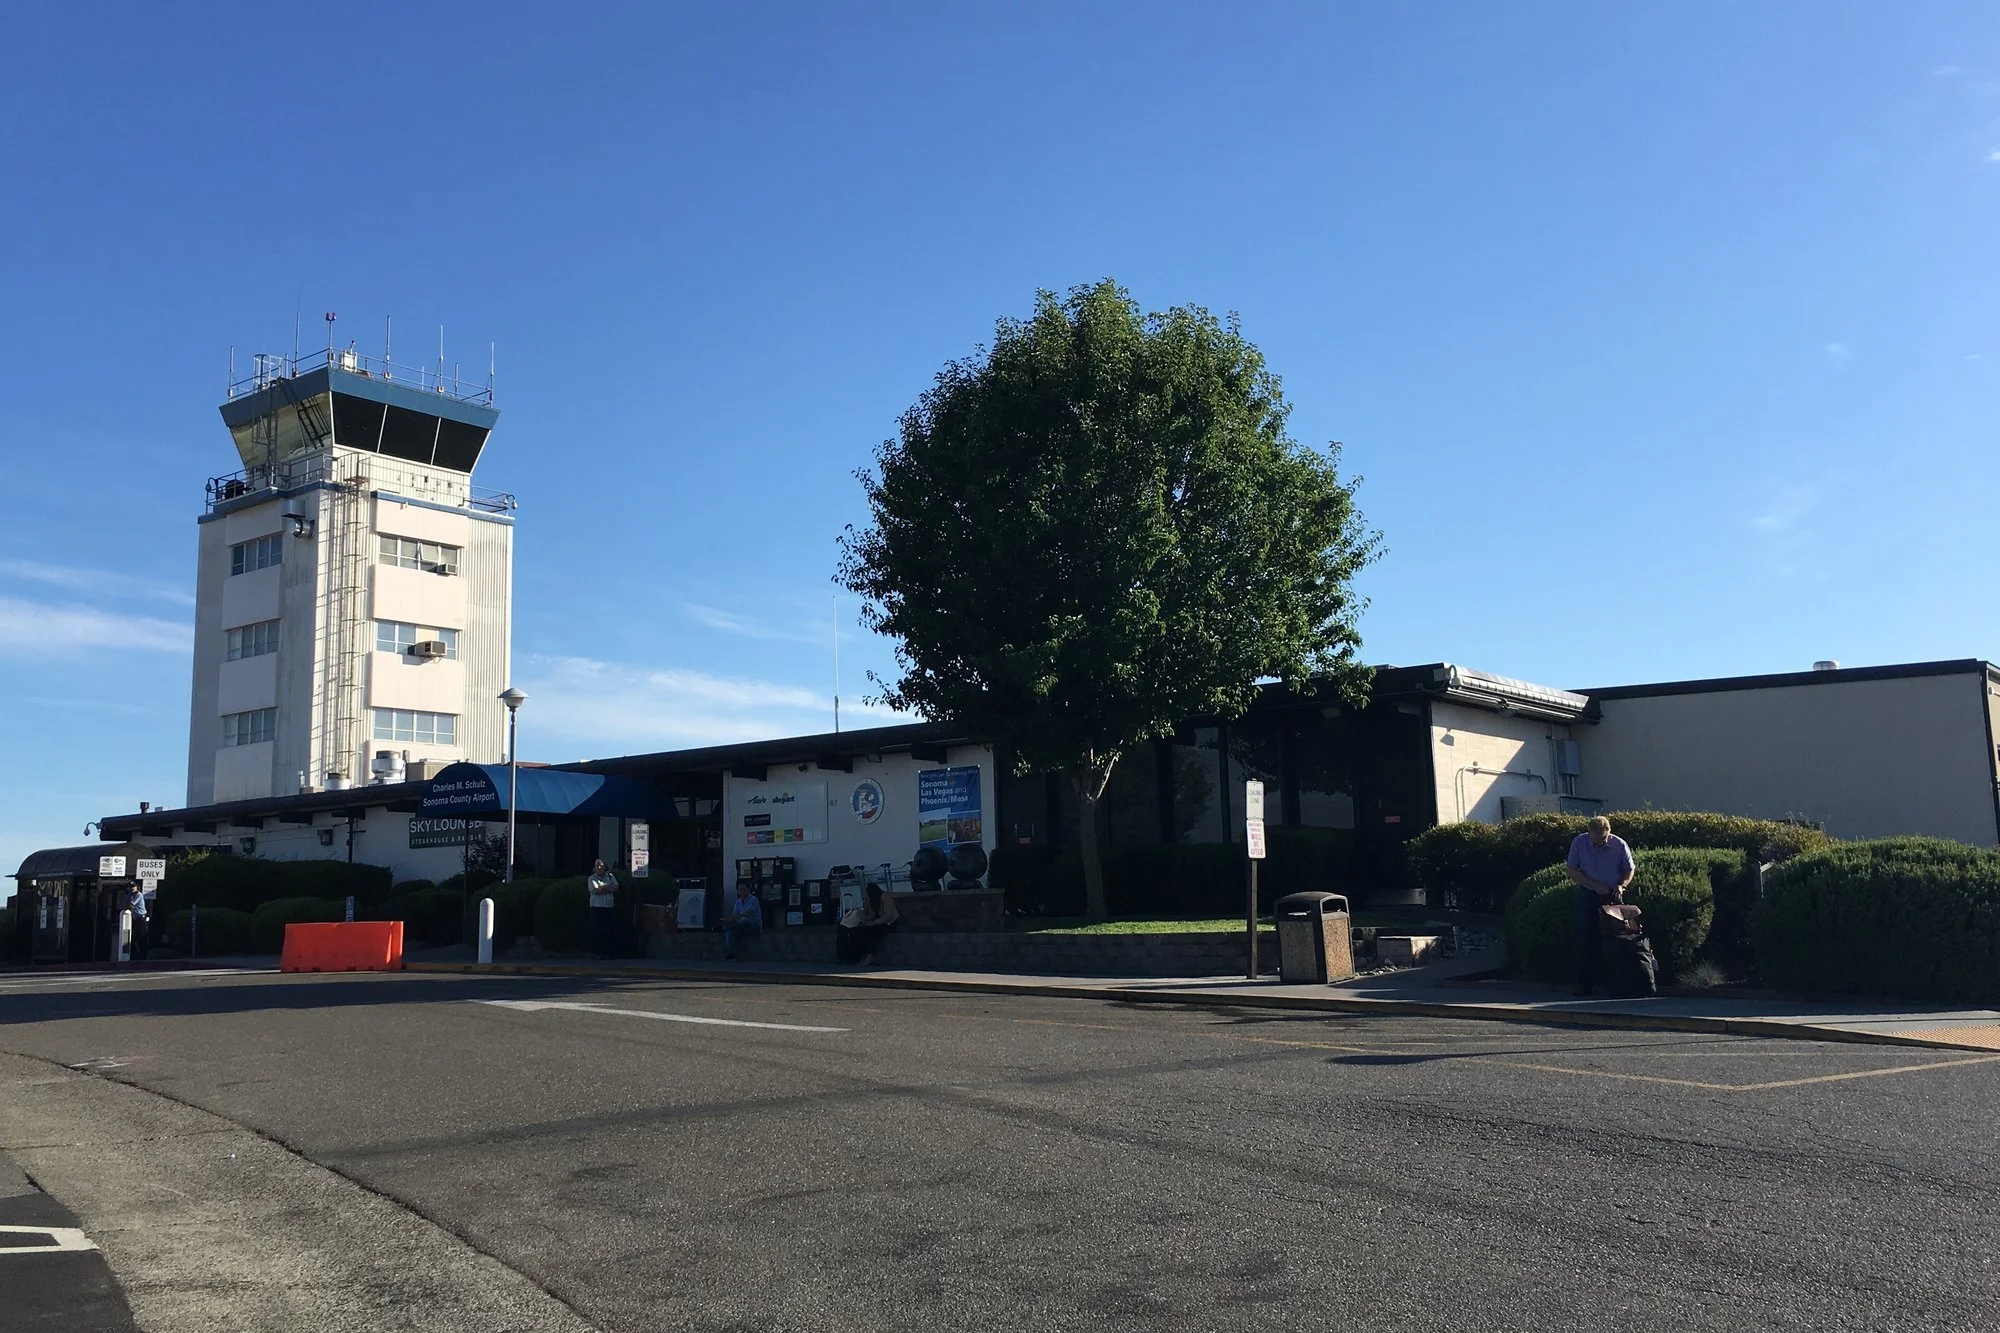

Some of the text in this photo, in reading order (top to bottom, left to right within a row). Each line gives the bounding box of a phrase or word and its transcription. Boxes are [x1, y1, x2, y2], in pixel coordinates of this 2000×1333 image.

[433, 780, 486, 792] Charles M. Schulz
[933, 788, 954, 797] Vegas
[423, 792, 495, 807] Sonoma County Airport
[410, 820, 431, 833] SKY
[141, 870, 160, 878] ONLY
